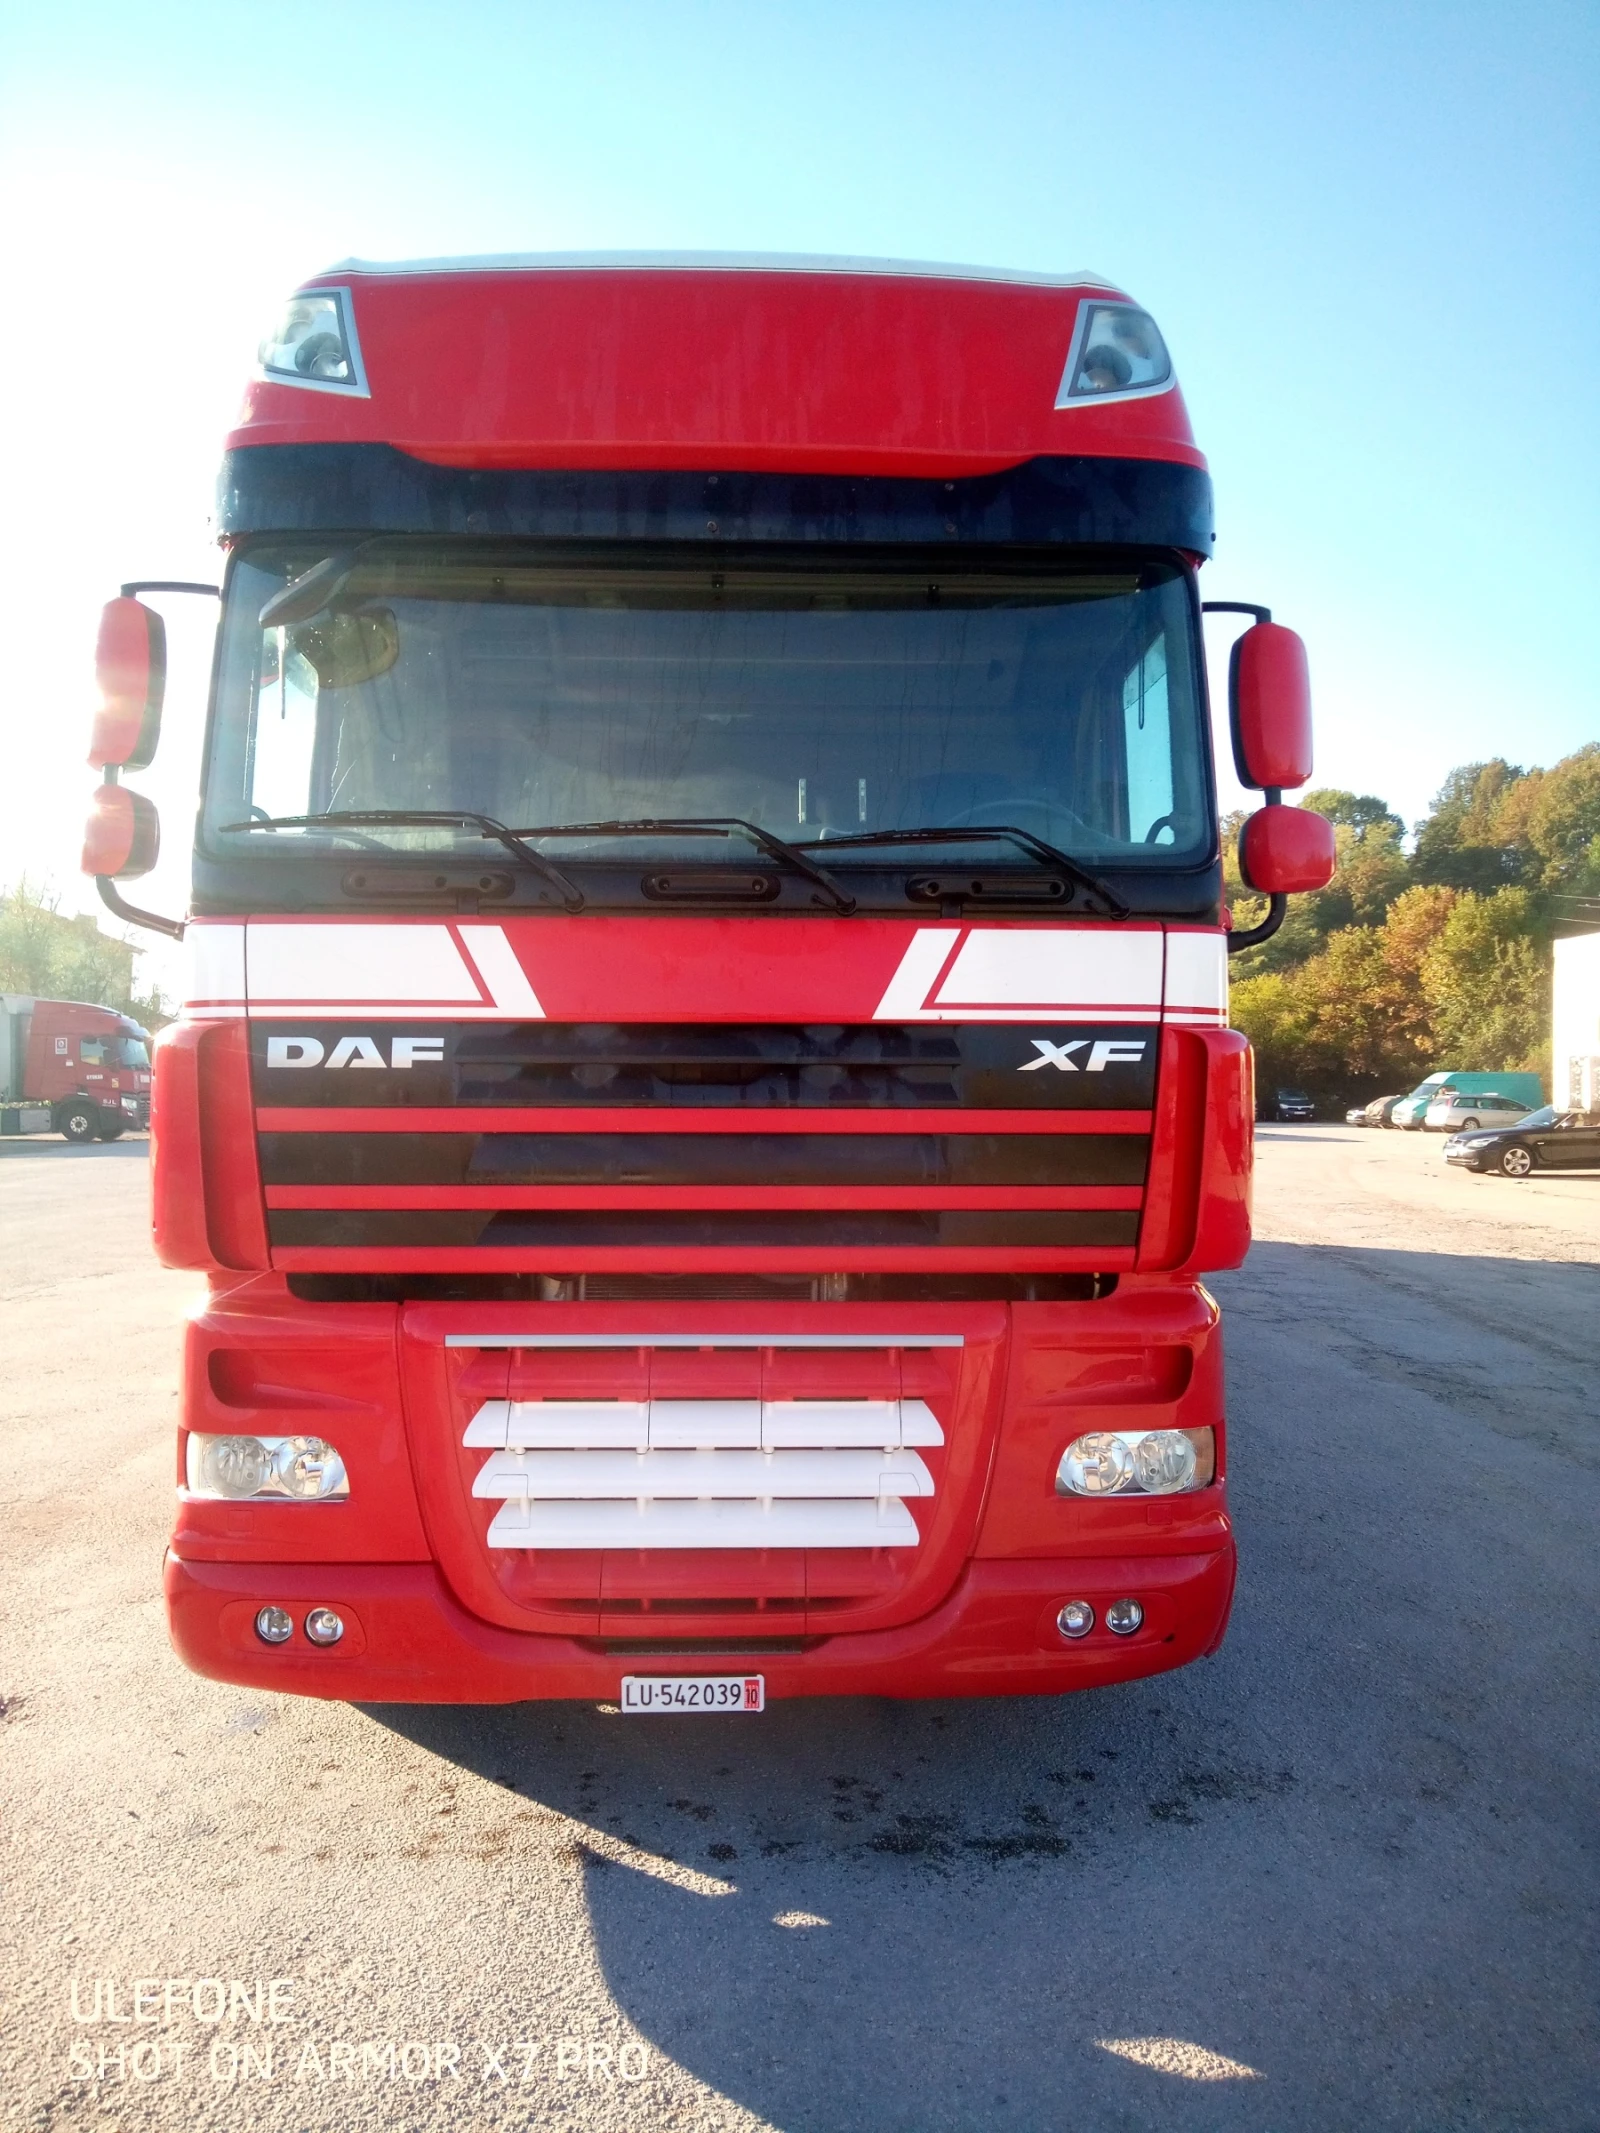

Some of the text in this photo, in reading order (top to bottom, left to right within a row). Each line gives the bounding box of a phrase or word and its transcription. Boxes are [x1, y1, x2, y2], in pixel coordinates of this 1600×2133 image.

[267, 1036, 445, 1069] DAF
[1016, 1040, 1147, 1071] XF
[745, 1688, 758, 1704] 10
